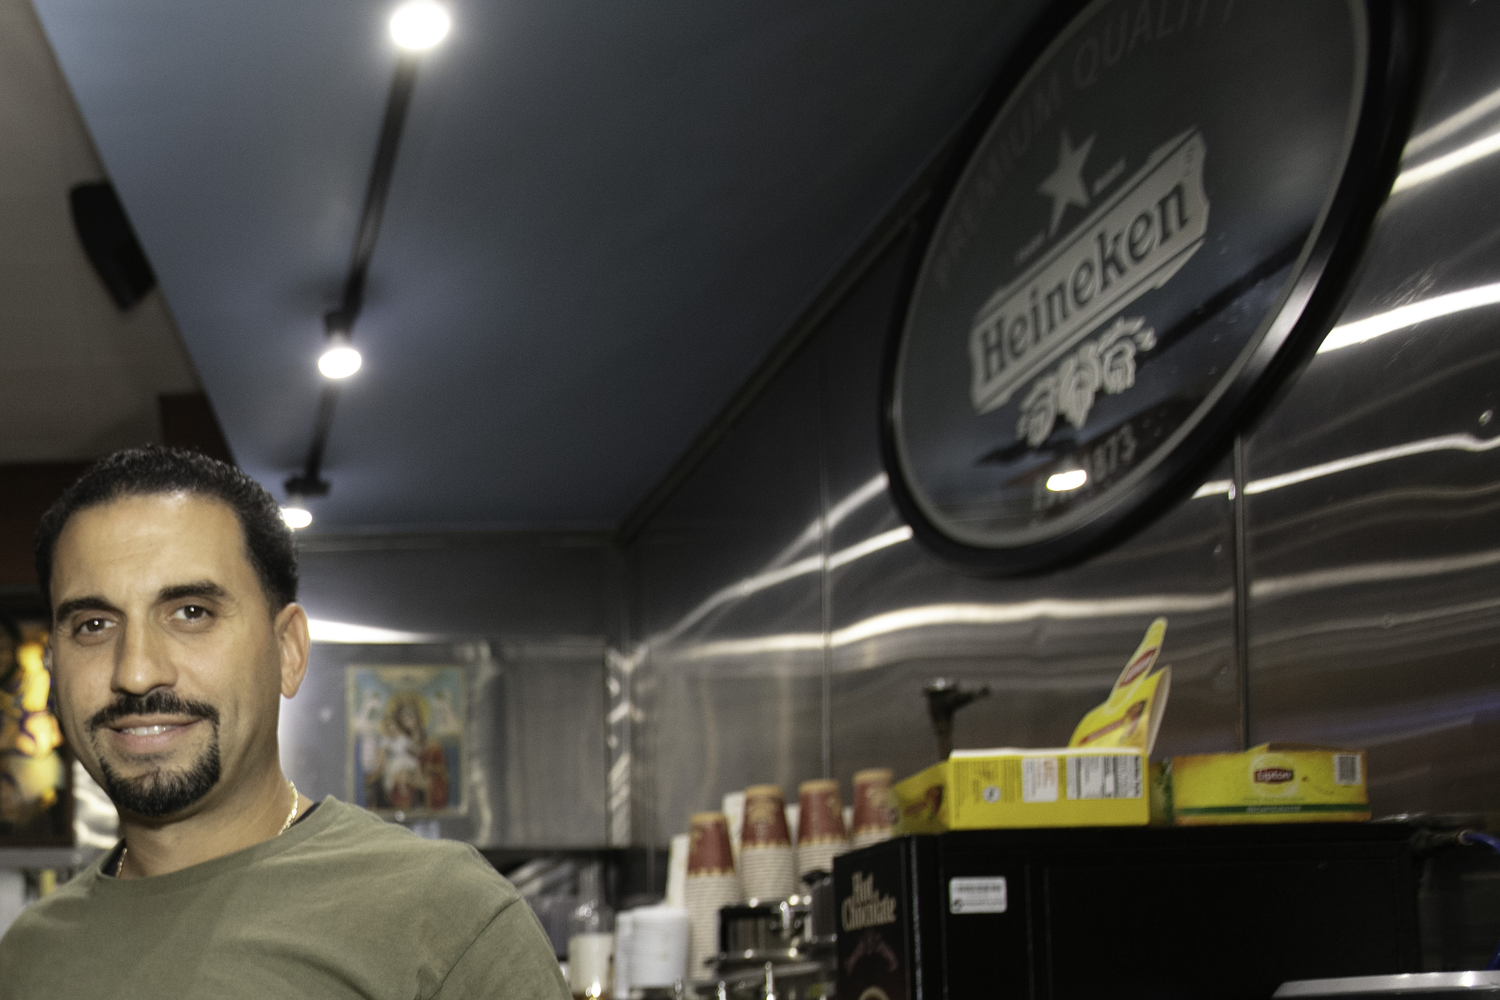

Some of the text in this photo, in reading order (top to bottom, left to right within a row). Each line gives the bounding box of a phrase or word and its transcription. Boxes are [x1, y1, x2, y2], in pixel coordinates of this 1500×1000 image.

[979, 182, 1192, 383] Heineken
[851, 871, 875, 906] Hot
[841, 889, 897, 933] Chocolate
